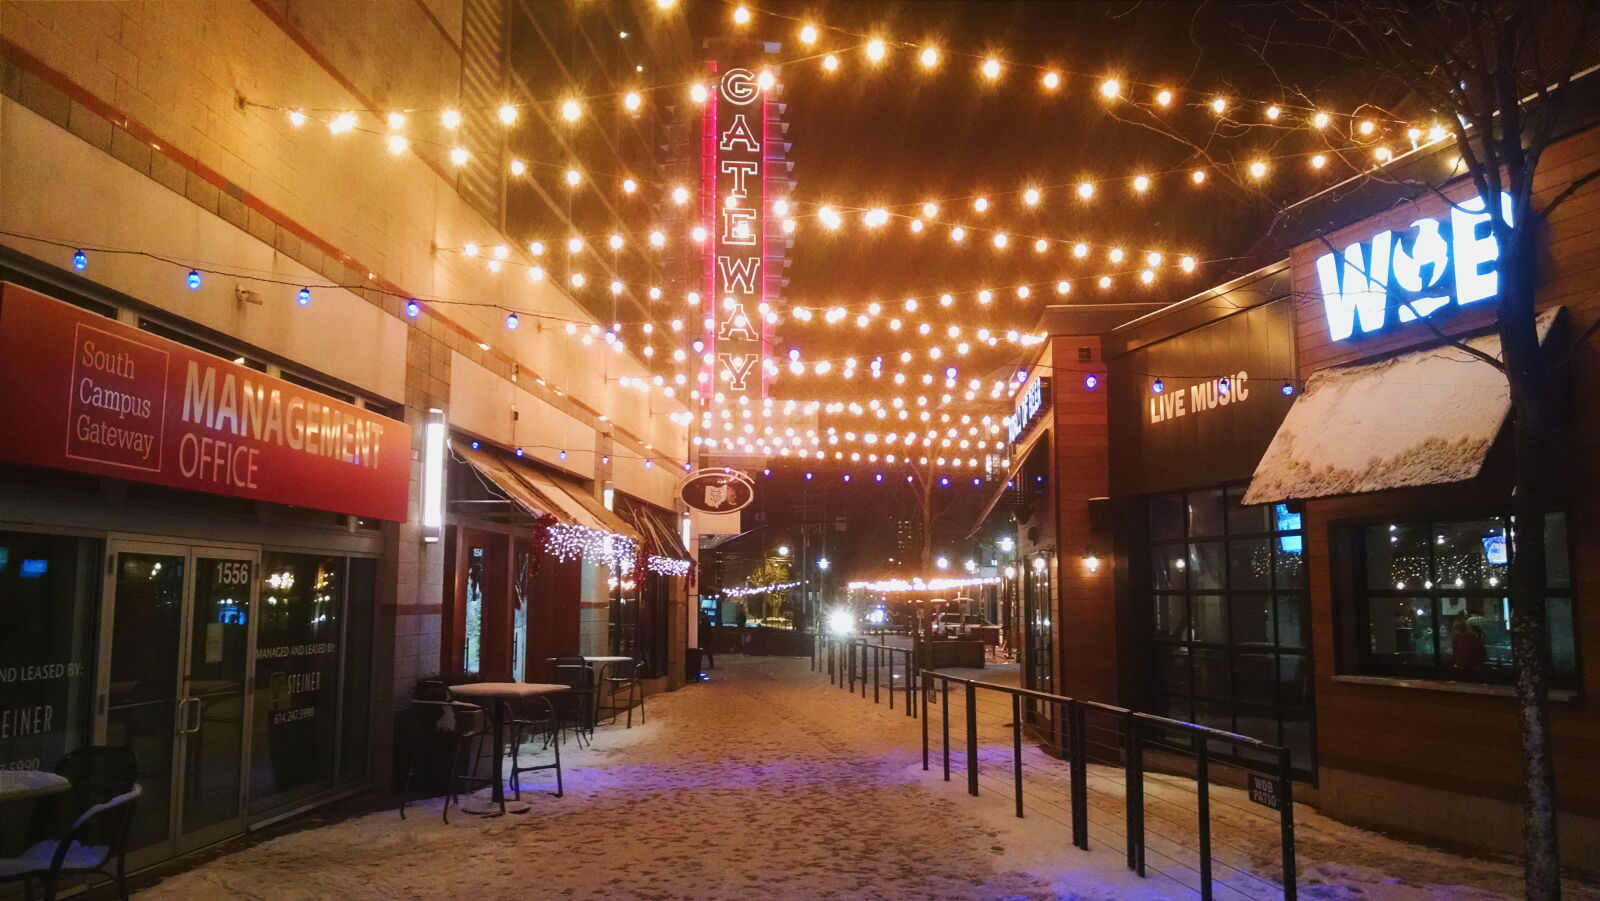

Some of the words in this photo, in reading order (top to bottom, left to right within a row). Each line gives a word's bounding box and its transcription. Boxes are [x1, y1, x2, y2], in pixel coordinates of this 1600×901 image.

[717, 67, 761, 391] GATEWAY
[81, 339, 136, 380] South
[79, 377, 152, 418] Campus
[181, 359, 384, 471] MANAGEMENT
[1150, 388, 1186, 424] LIVE
[1191, 370, 1249, 413] MUSIC
[76, 415, 155, 460] Gateway
[179, 432, 260, 490] OFFICE
[216, 562, 249, 585] 1556
[256, 646, 289, 660] MANAGED
[290, 645, 305, 656] AND
[305, 643, 327, 655] LEASED
[21, 664, 65, 681] LEASED
[67, 662, 85, 677] BY:
[287, 671, 321, 695] STEINER
[1, 705, 53, 739] EINER
[1253, 788, 1278, 807] PATIO
[1254, 776, 1274, 793] WOB
